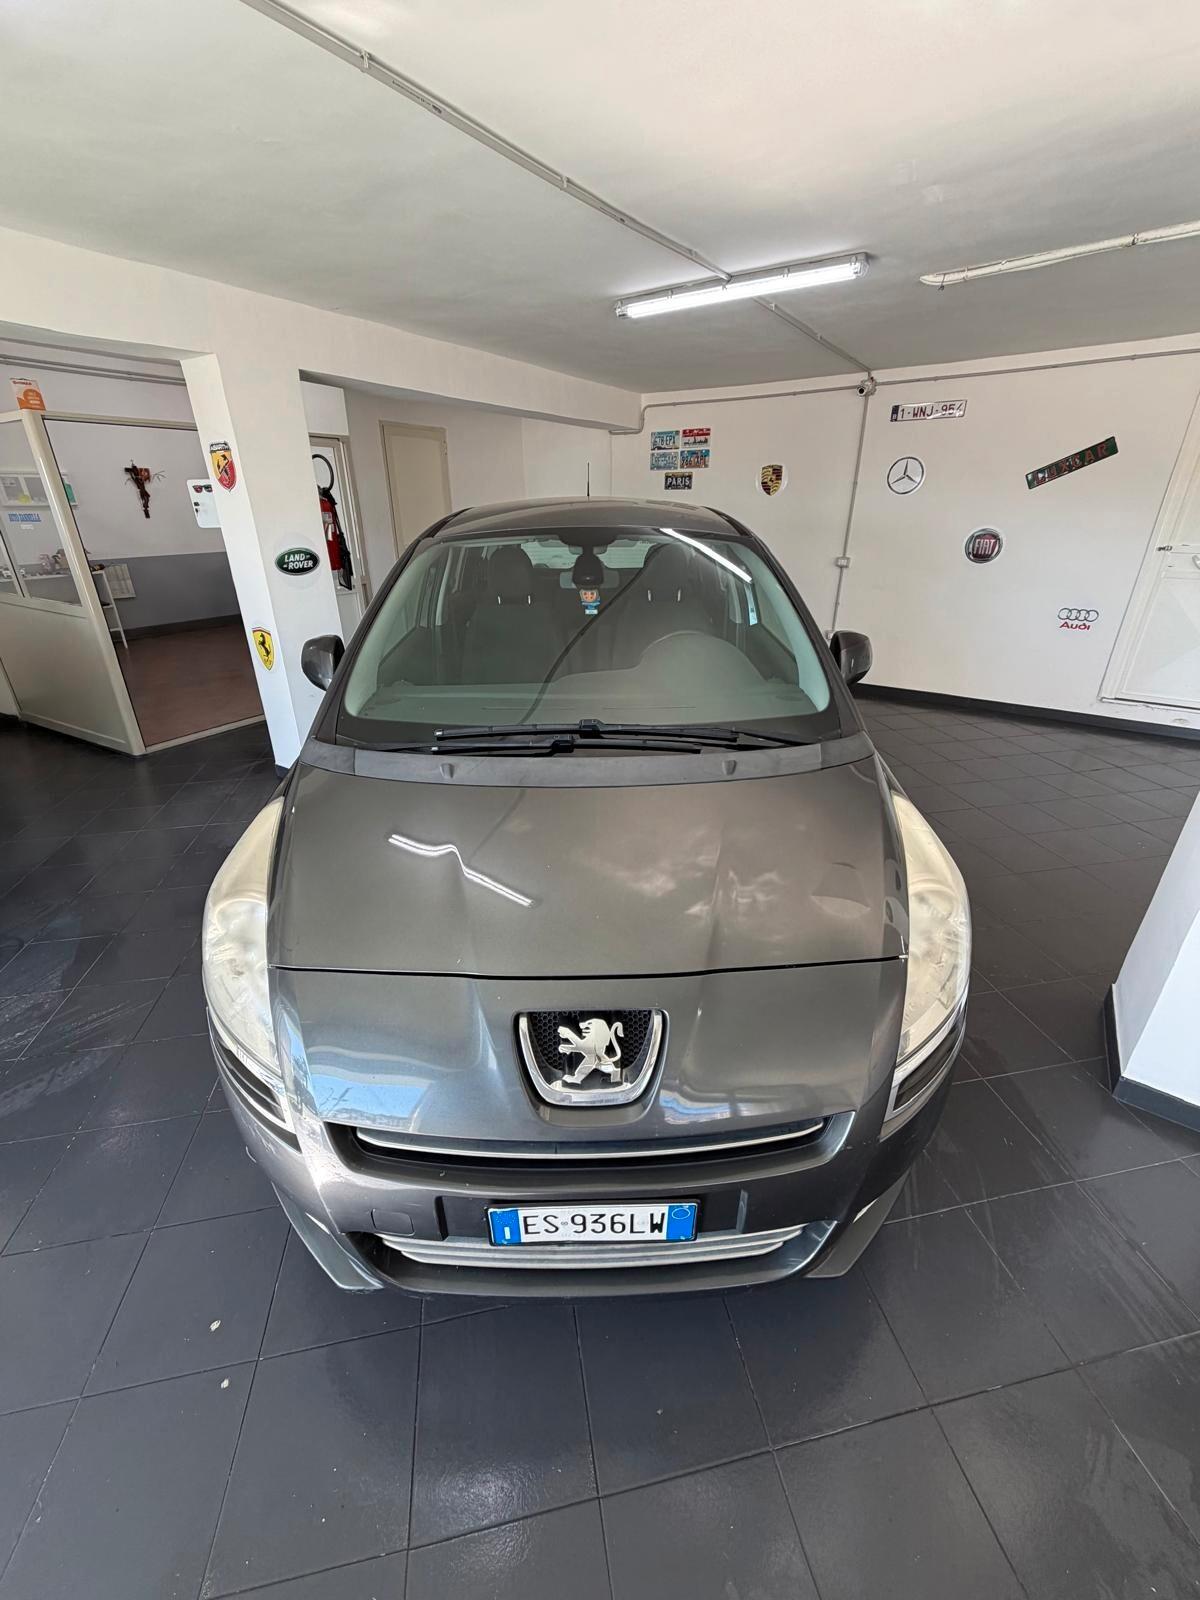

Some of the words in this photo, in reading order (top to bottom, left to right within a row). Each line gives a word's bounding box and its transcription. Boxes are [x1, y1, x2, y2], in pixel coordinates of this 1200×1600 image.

[667, 477, 690, 486] PARIS
[974, 539, 997, 555] FIAT
[1059, 621, 1091, 631] Audi
